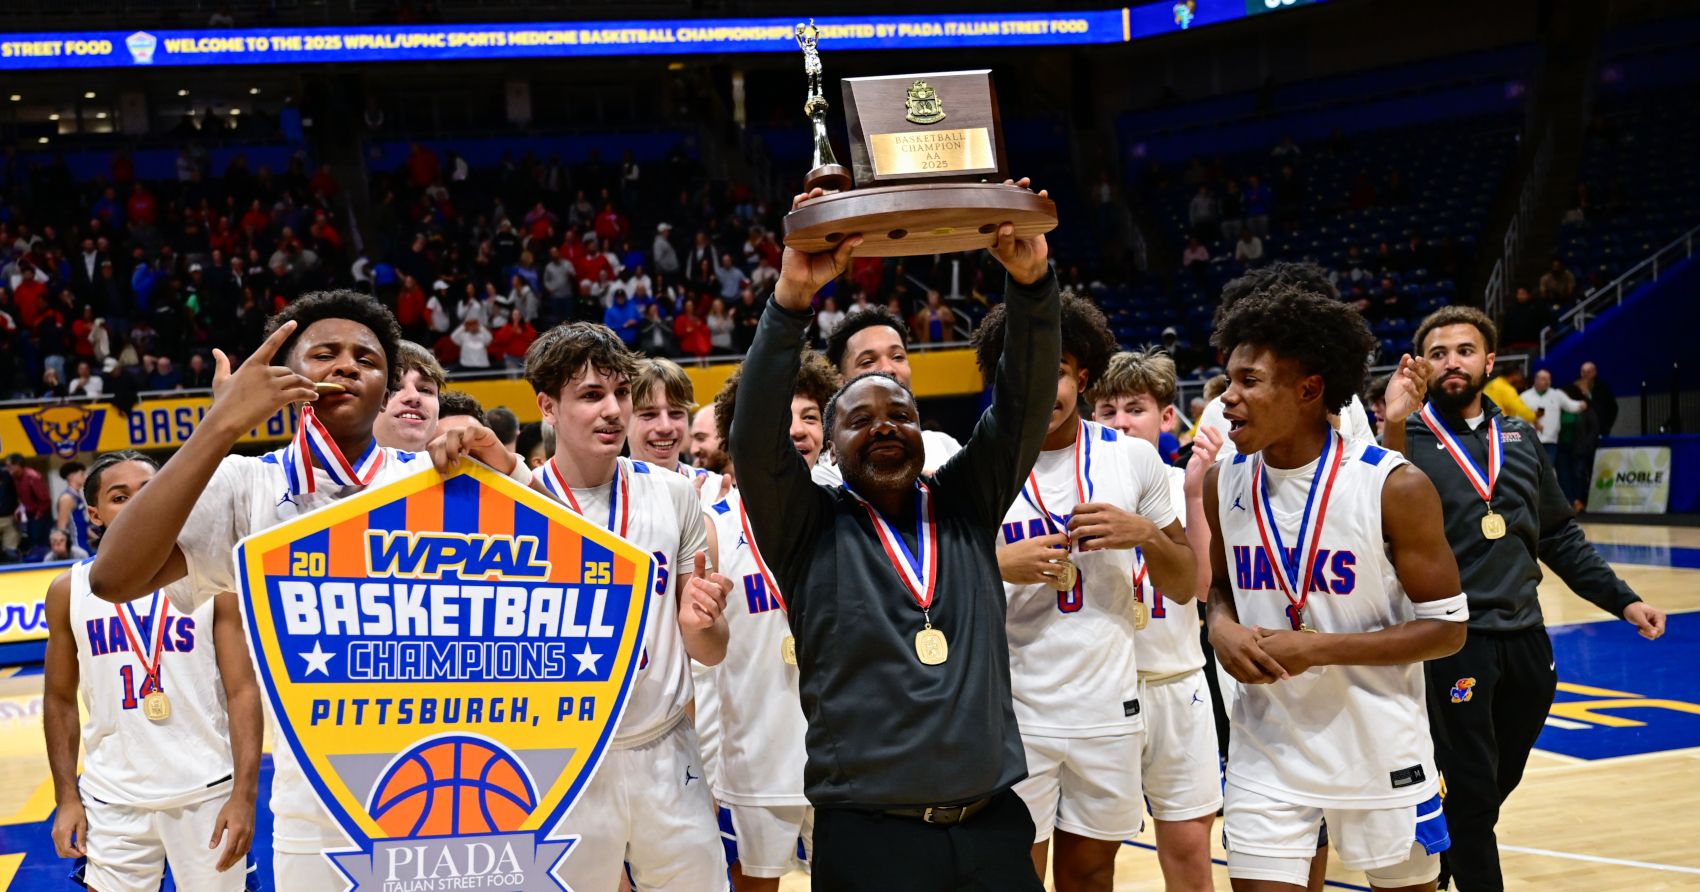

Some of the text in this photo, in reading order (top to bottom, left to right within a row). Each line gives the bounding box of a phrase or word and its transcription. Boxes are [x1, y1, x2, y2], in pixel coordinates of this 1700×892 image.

[164, 37, 245, 53] WELCOME
[246, 37, 269, 52] TO
[270, 36, 303, 51] THE
[304, 35, 342, 50] 2025
[343, 33, 446, 49] WPIAL/UPMC
[447, 31, 506, 47] SPORTS
[508, 30, 578, 46] MEDICINE
[579, 28, 676, 44] BASKETBALL
[677, 25, 794, 42] CHAMPIONSHIPS
[876, 24, 897, 38] BY
[898, 22, 943, 37] PIADA
[944, 21, 999, 36] ITALIAN
[1001, 20, 1049, 35] STREET
[1050, 19, 1088, 33] FOOD
[1, 40, 112, 57] STREET FOOD
[895, 132, 966, 144] BASKETBALL
[901, 141, 961, 152] CHAMPION
[921, 160, 949, 170] 2025
[926, 152, 941, 160] AA
[1616, 471, 1664, 484] NOBLE
[292, 552, 326, 577] 20
[366, 531, 551, 581] WPIAL
[584, 561, 611, 585] 25
[278, 580, 614, 638] BASKETBALL
[347, 640, 566, 680] CHAMPIONS
[310, 696, 596, 727] PITTSBURGH, PA
[385, 840, 524, 881] PIADA
[383, 873, 525, 892] ITALIAN STREET FOOD
